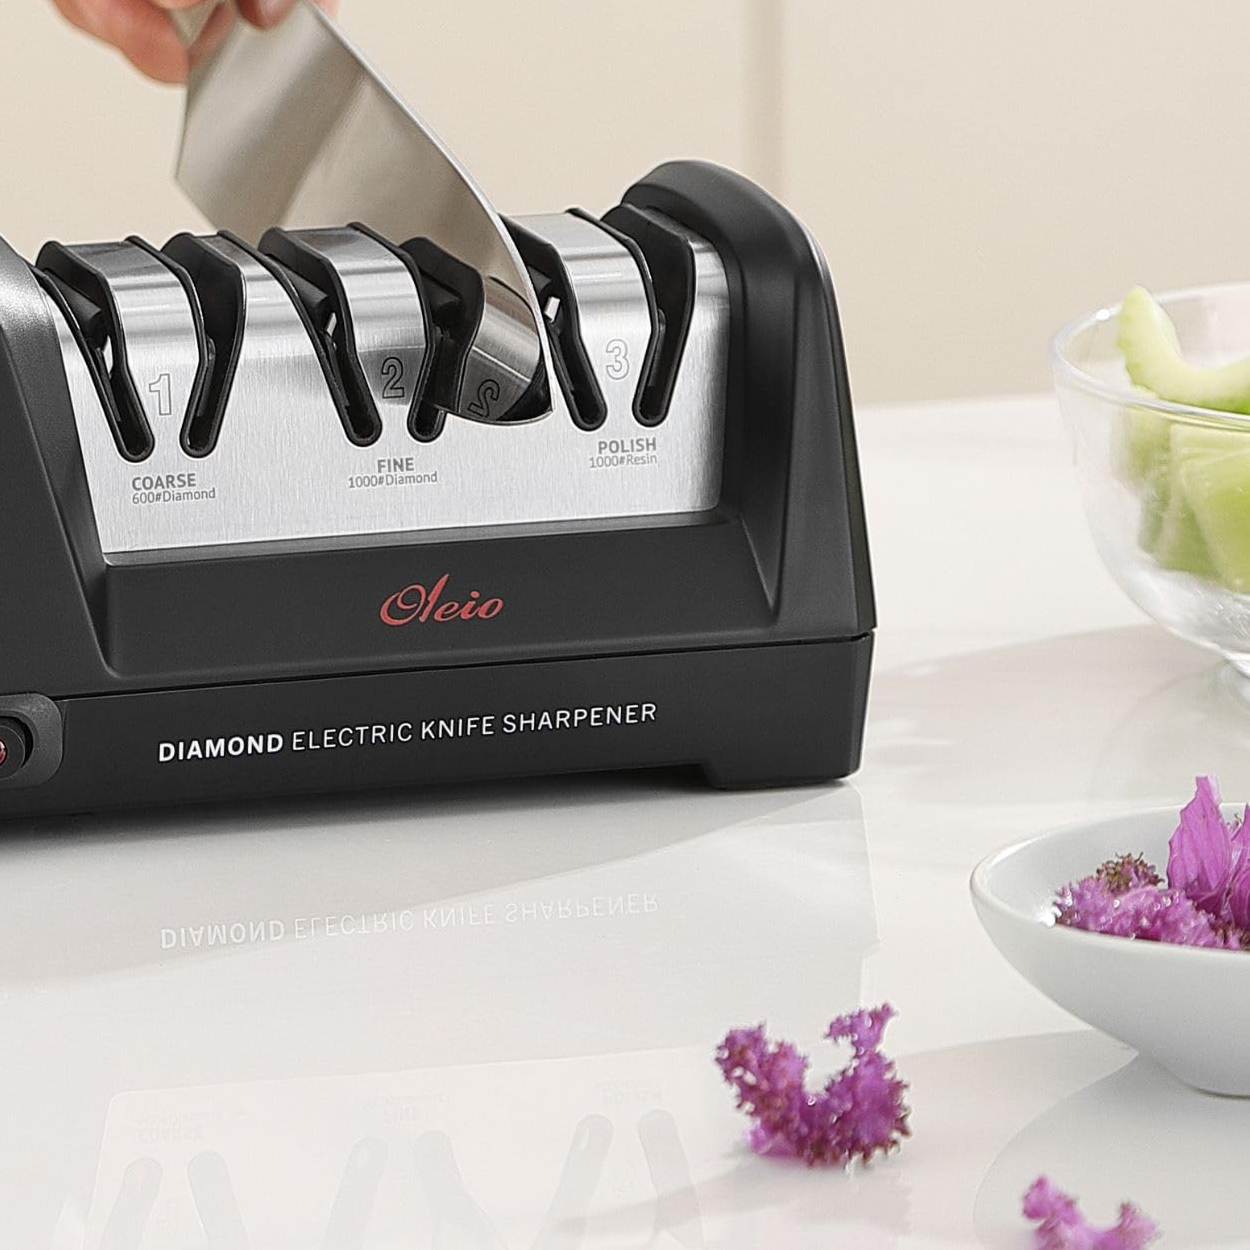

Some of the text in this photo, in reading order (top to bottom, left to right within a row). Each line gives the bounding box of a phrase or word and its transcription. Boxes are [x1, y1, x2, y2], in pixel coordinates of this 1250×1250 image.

[605, 338, 630, 381] 3
[381, 356, 405, 399] 2
[148, 373, 172, 416] 1
[597, 437, 657, 454] POLISH
[377, 457, 415, 473] FINE
[589, 453, 658, 469] 1000#Resin
[131, 473, 197, 491] COARSE
[348, 471, 438, 489] 1000#Diamond
[132, 487, 216, 504] 600#Diamond
[158, 702, 658, 763] DIAMOND ELECTRIC KNIFE SHARPENER
